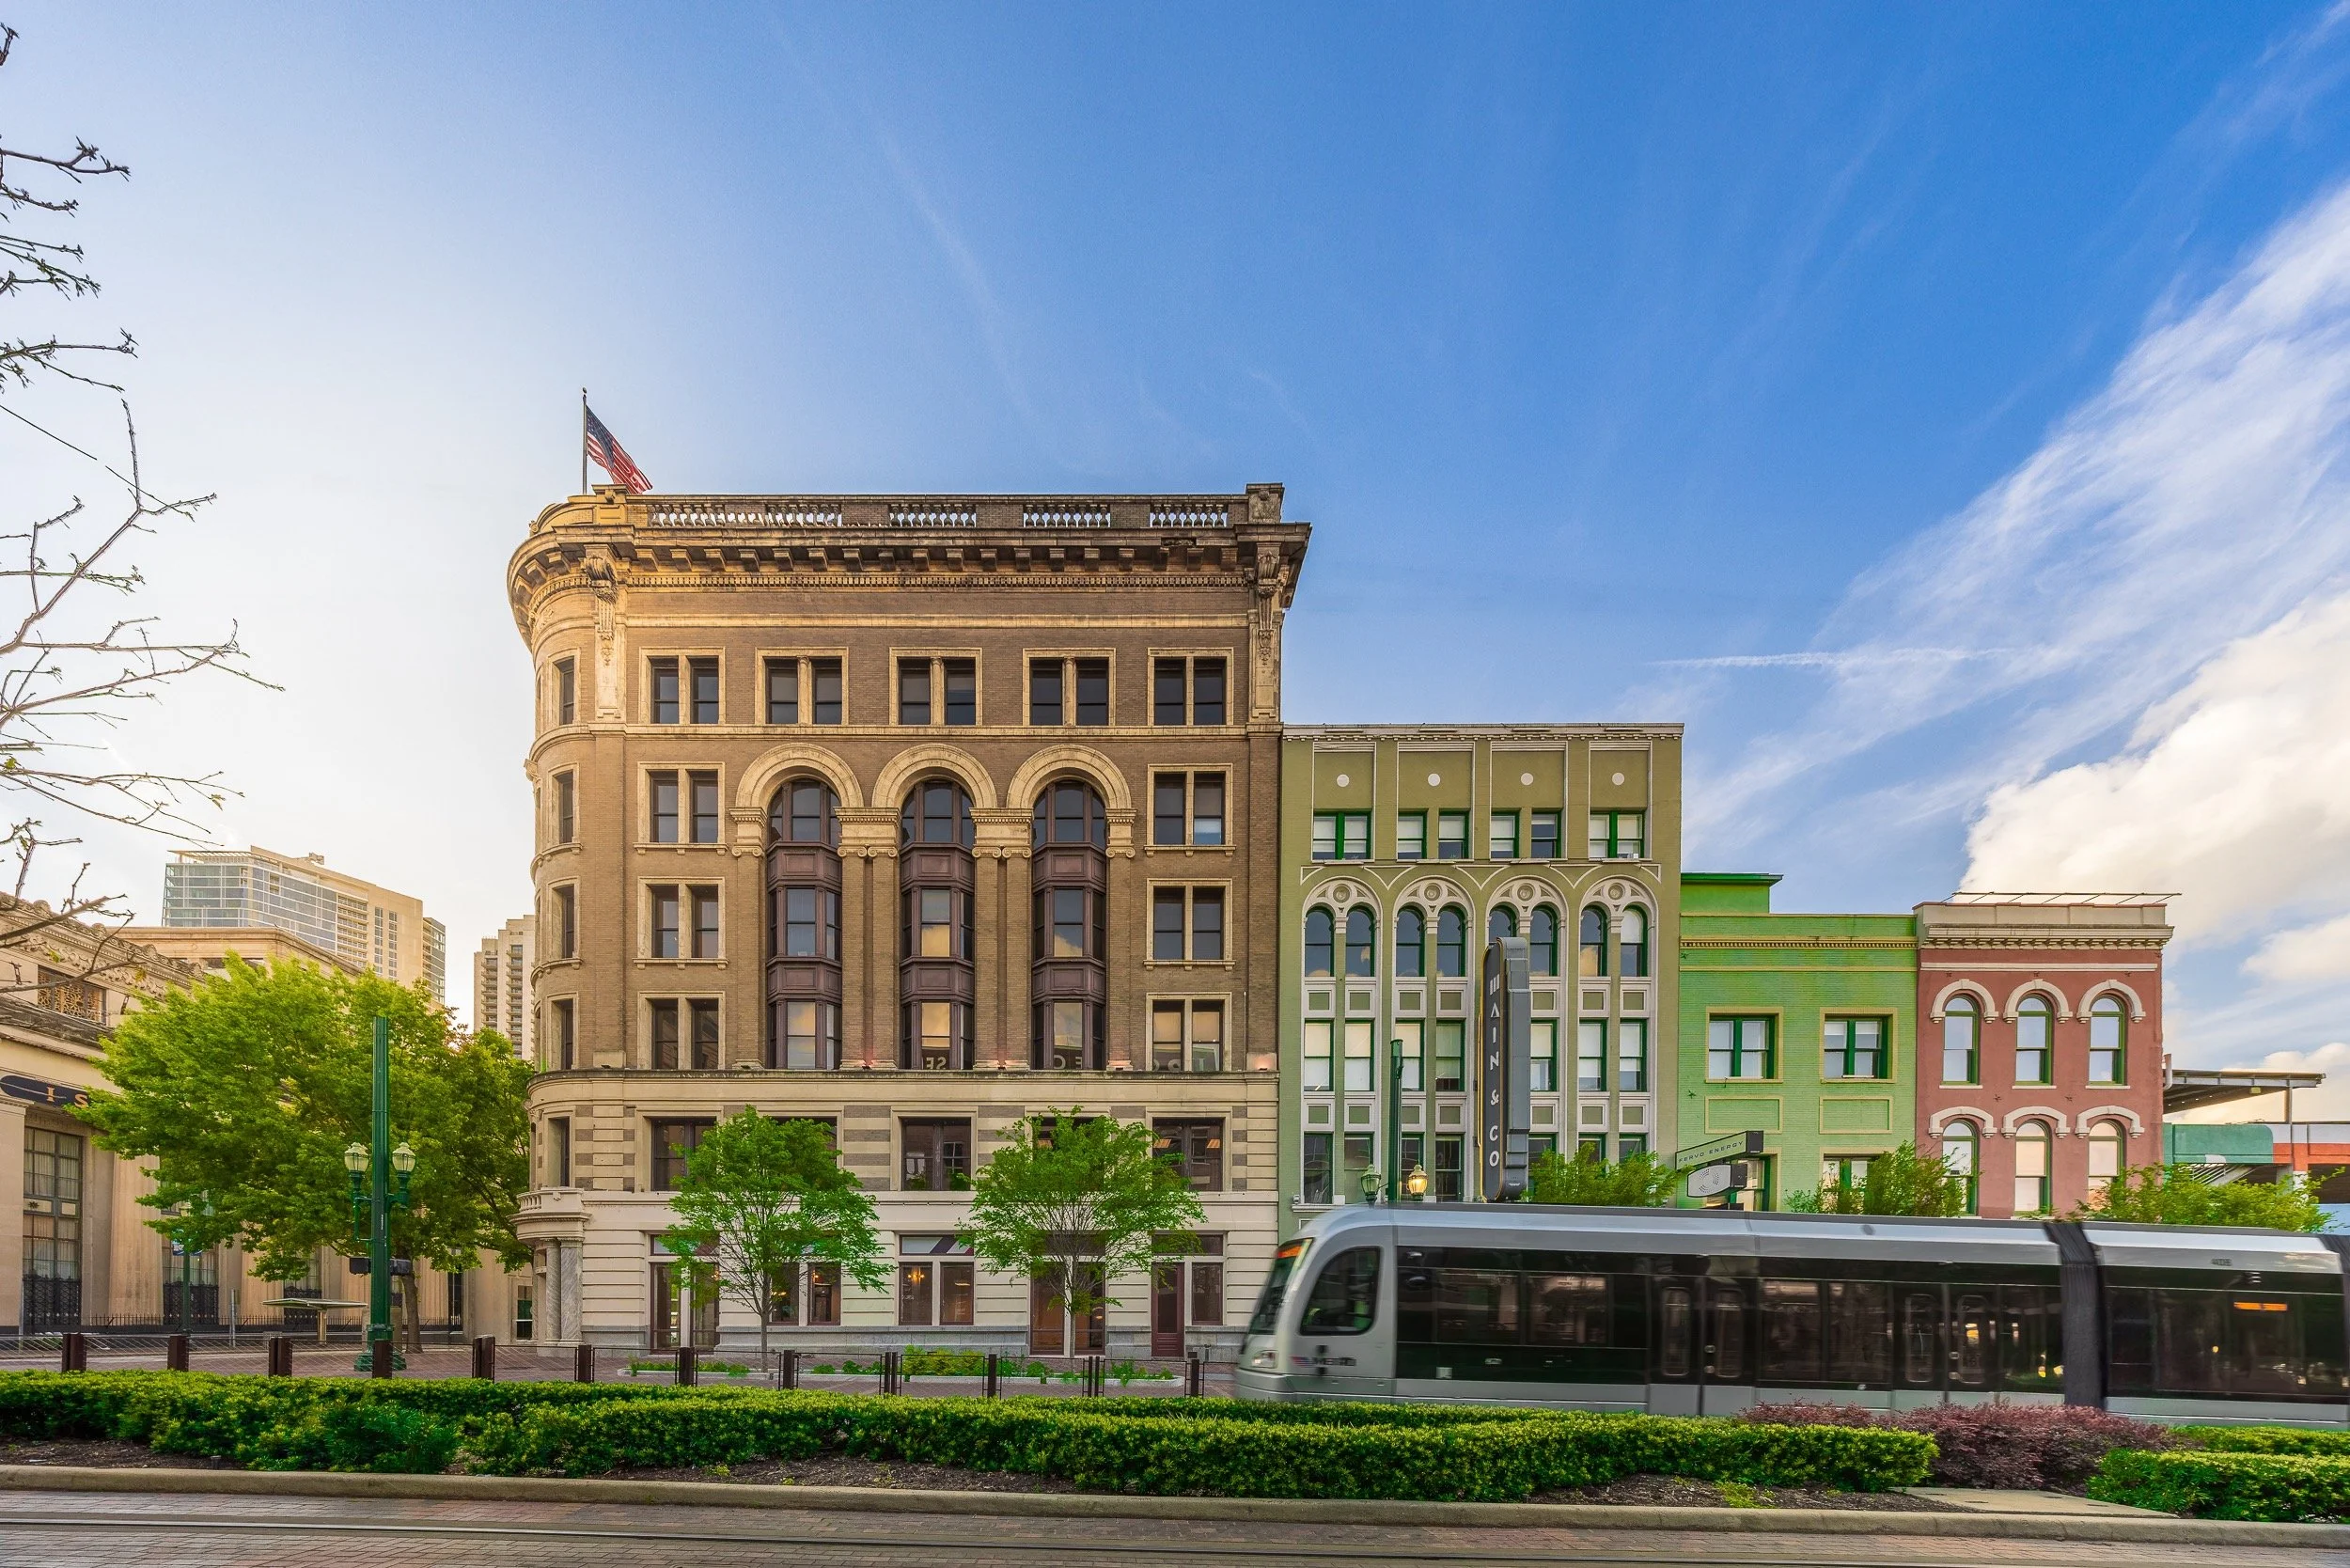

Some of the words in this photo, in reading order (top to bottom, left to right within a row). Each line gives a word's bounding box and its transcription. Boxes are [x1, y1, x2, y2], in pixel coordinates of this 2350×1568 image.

[1490, 1089, 1499, 1105] &
[1489, 1124, 1500, 1167] CO
[1678, 1152, 1705, 1163] FERVO
[1708, 1140, 1744, 1154] ENERGY
